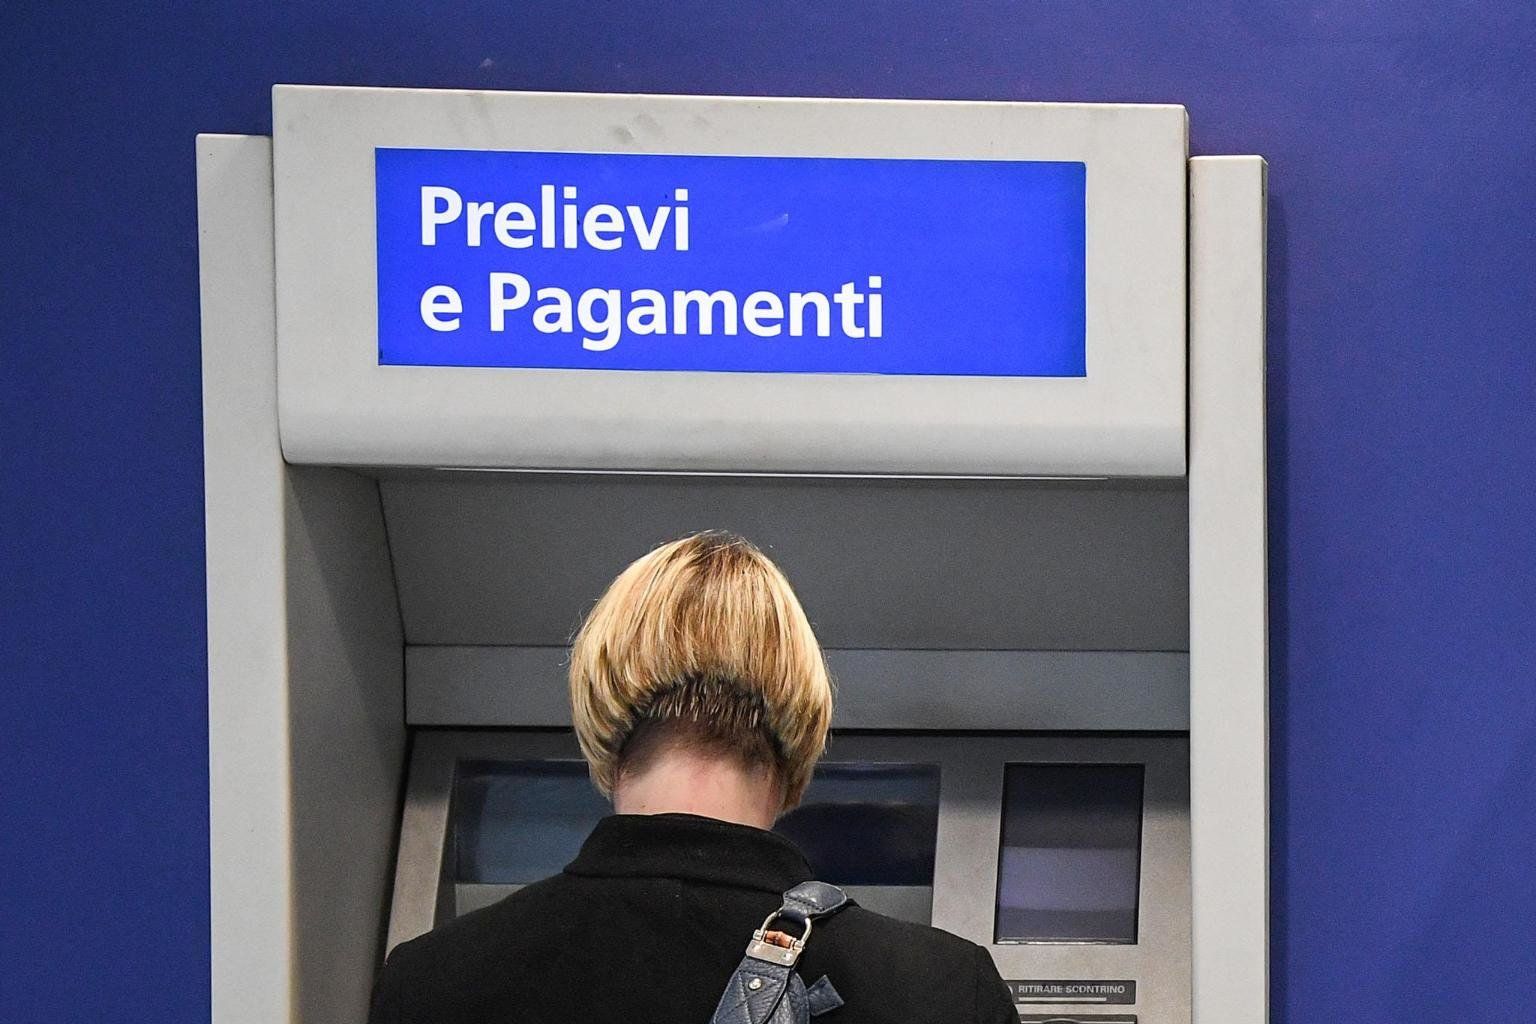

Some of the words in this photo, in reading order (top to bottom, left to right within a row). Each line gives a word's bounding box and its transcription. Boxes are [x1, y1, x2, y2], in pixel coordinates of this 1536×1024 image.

[420, 185, 690, 251] Prelievi
[420, 284, 463, 332] e
[488, 272, 884, 352] Pagamenti
[1018, 985, 1063, 994] RITIRARE
[1065, 985, 1126, 994] SCONTRINO
